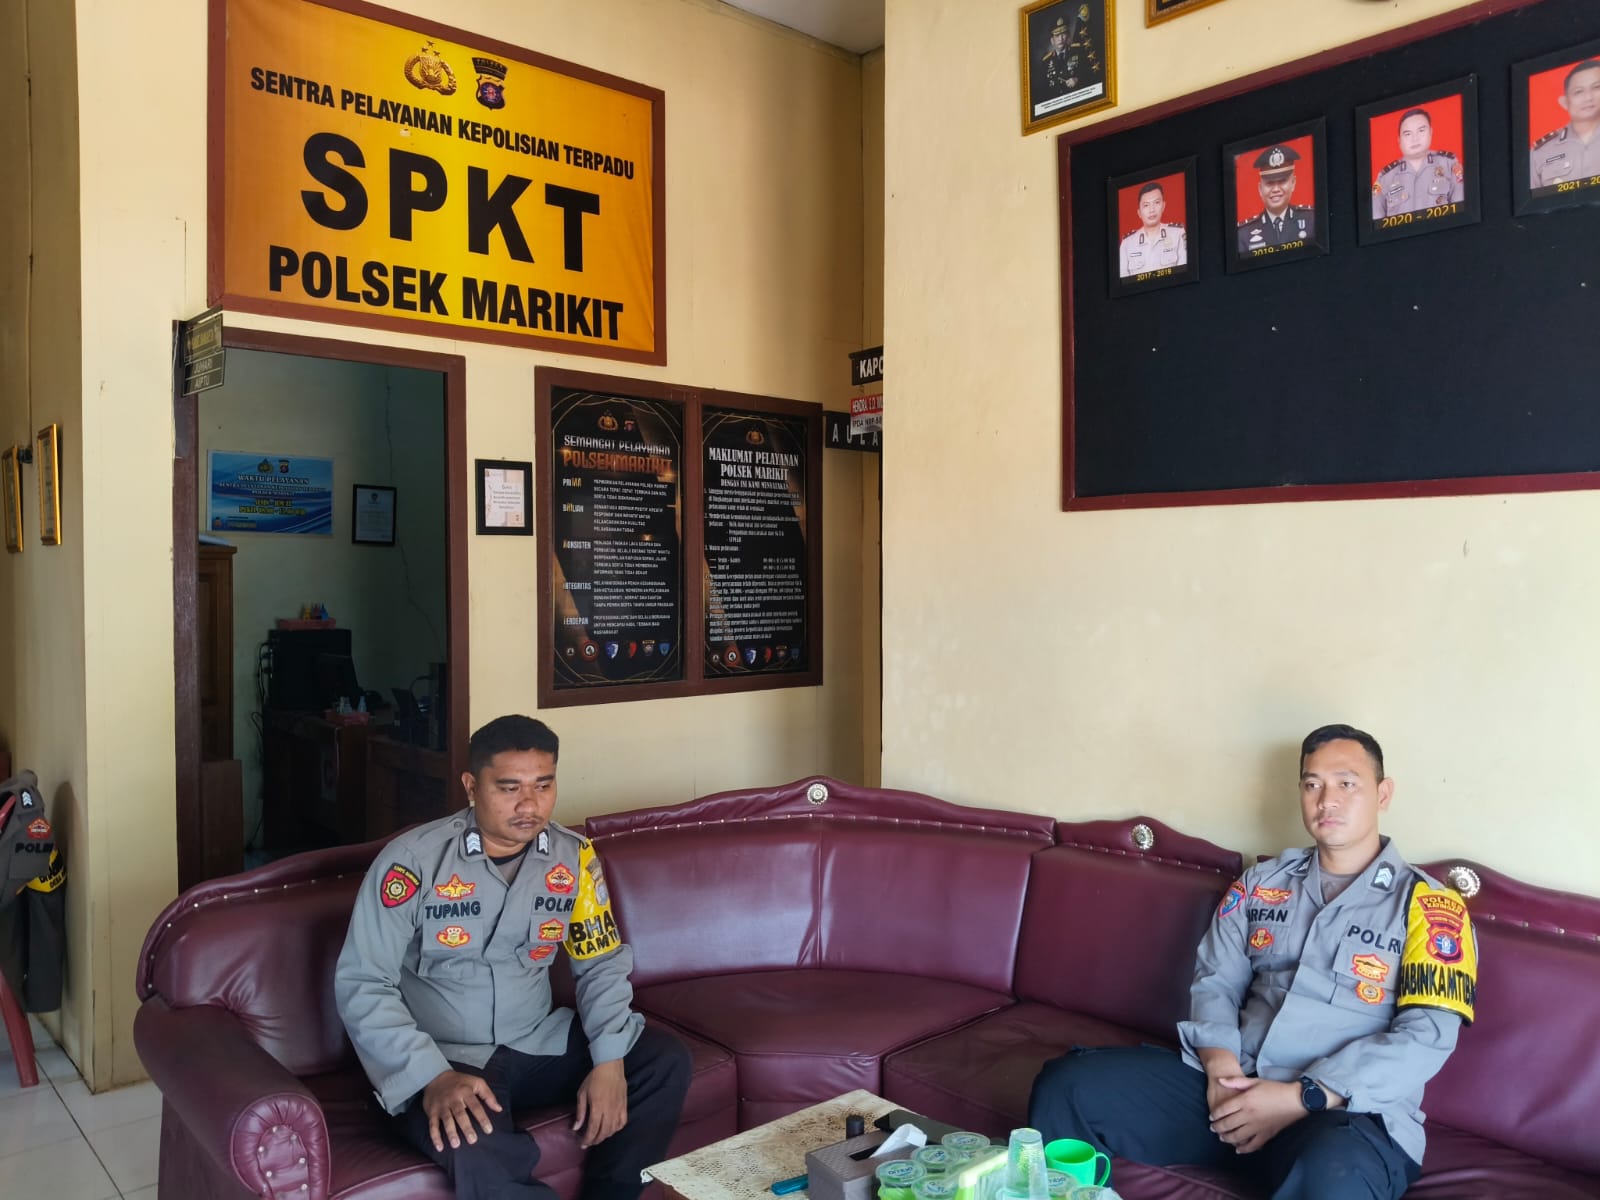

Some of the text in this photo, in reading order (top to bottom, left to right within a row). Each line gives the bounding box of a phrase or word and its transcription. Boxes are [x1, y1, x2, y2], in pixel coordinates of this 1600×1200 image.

[250, 67, 634, 180] SENTRA PELAYANAN KEPOLISIAN TERPADU
[1558, 180, 1580, 192] 2021
[301, 132, 600, 273] SPKT
[1382, 212, 1412, 228] 2020
[1426, 203, 1457, 220] 2021
[269, 245, 624, 341] POLSEK MARIKIT
[564, 434, 615, 450] SEMANGAT
[708, 447, 800, 467] MAKLUMAT PELAYANAN
[720, 463, 789, 481] POLSEK MARIKIT
[425, 901, 481, 919] TUPANG
